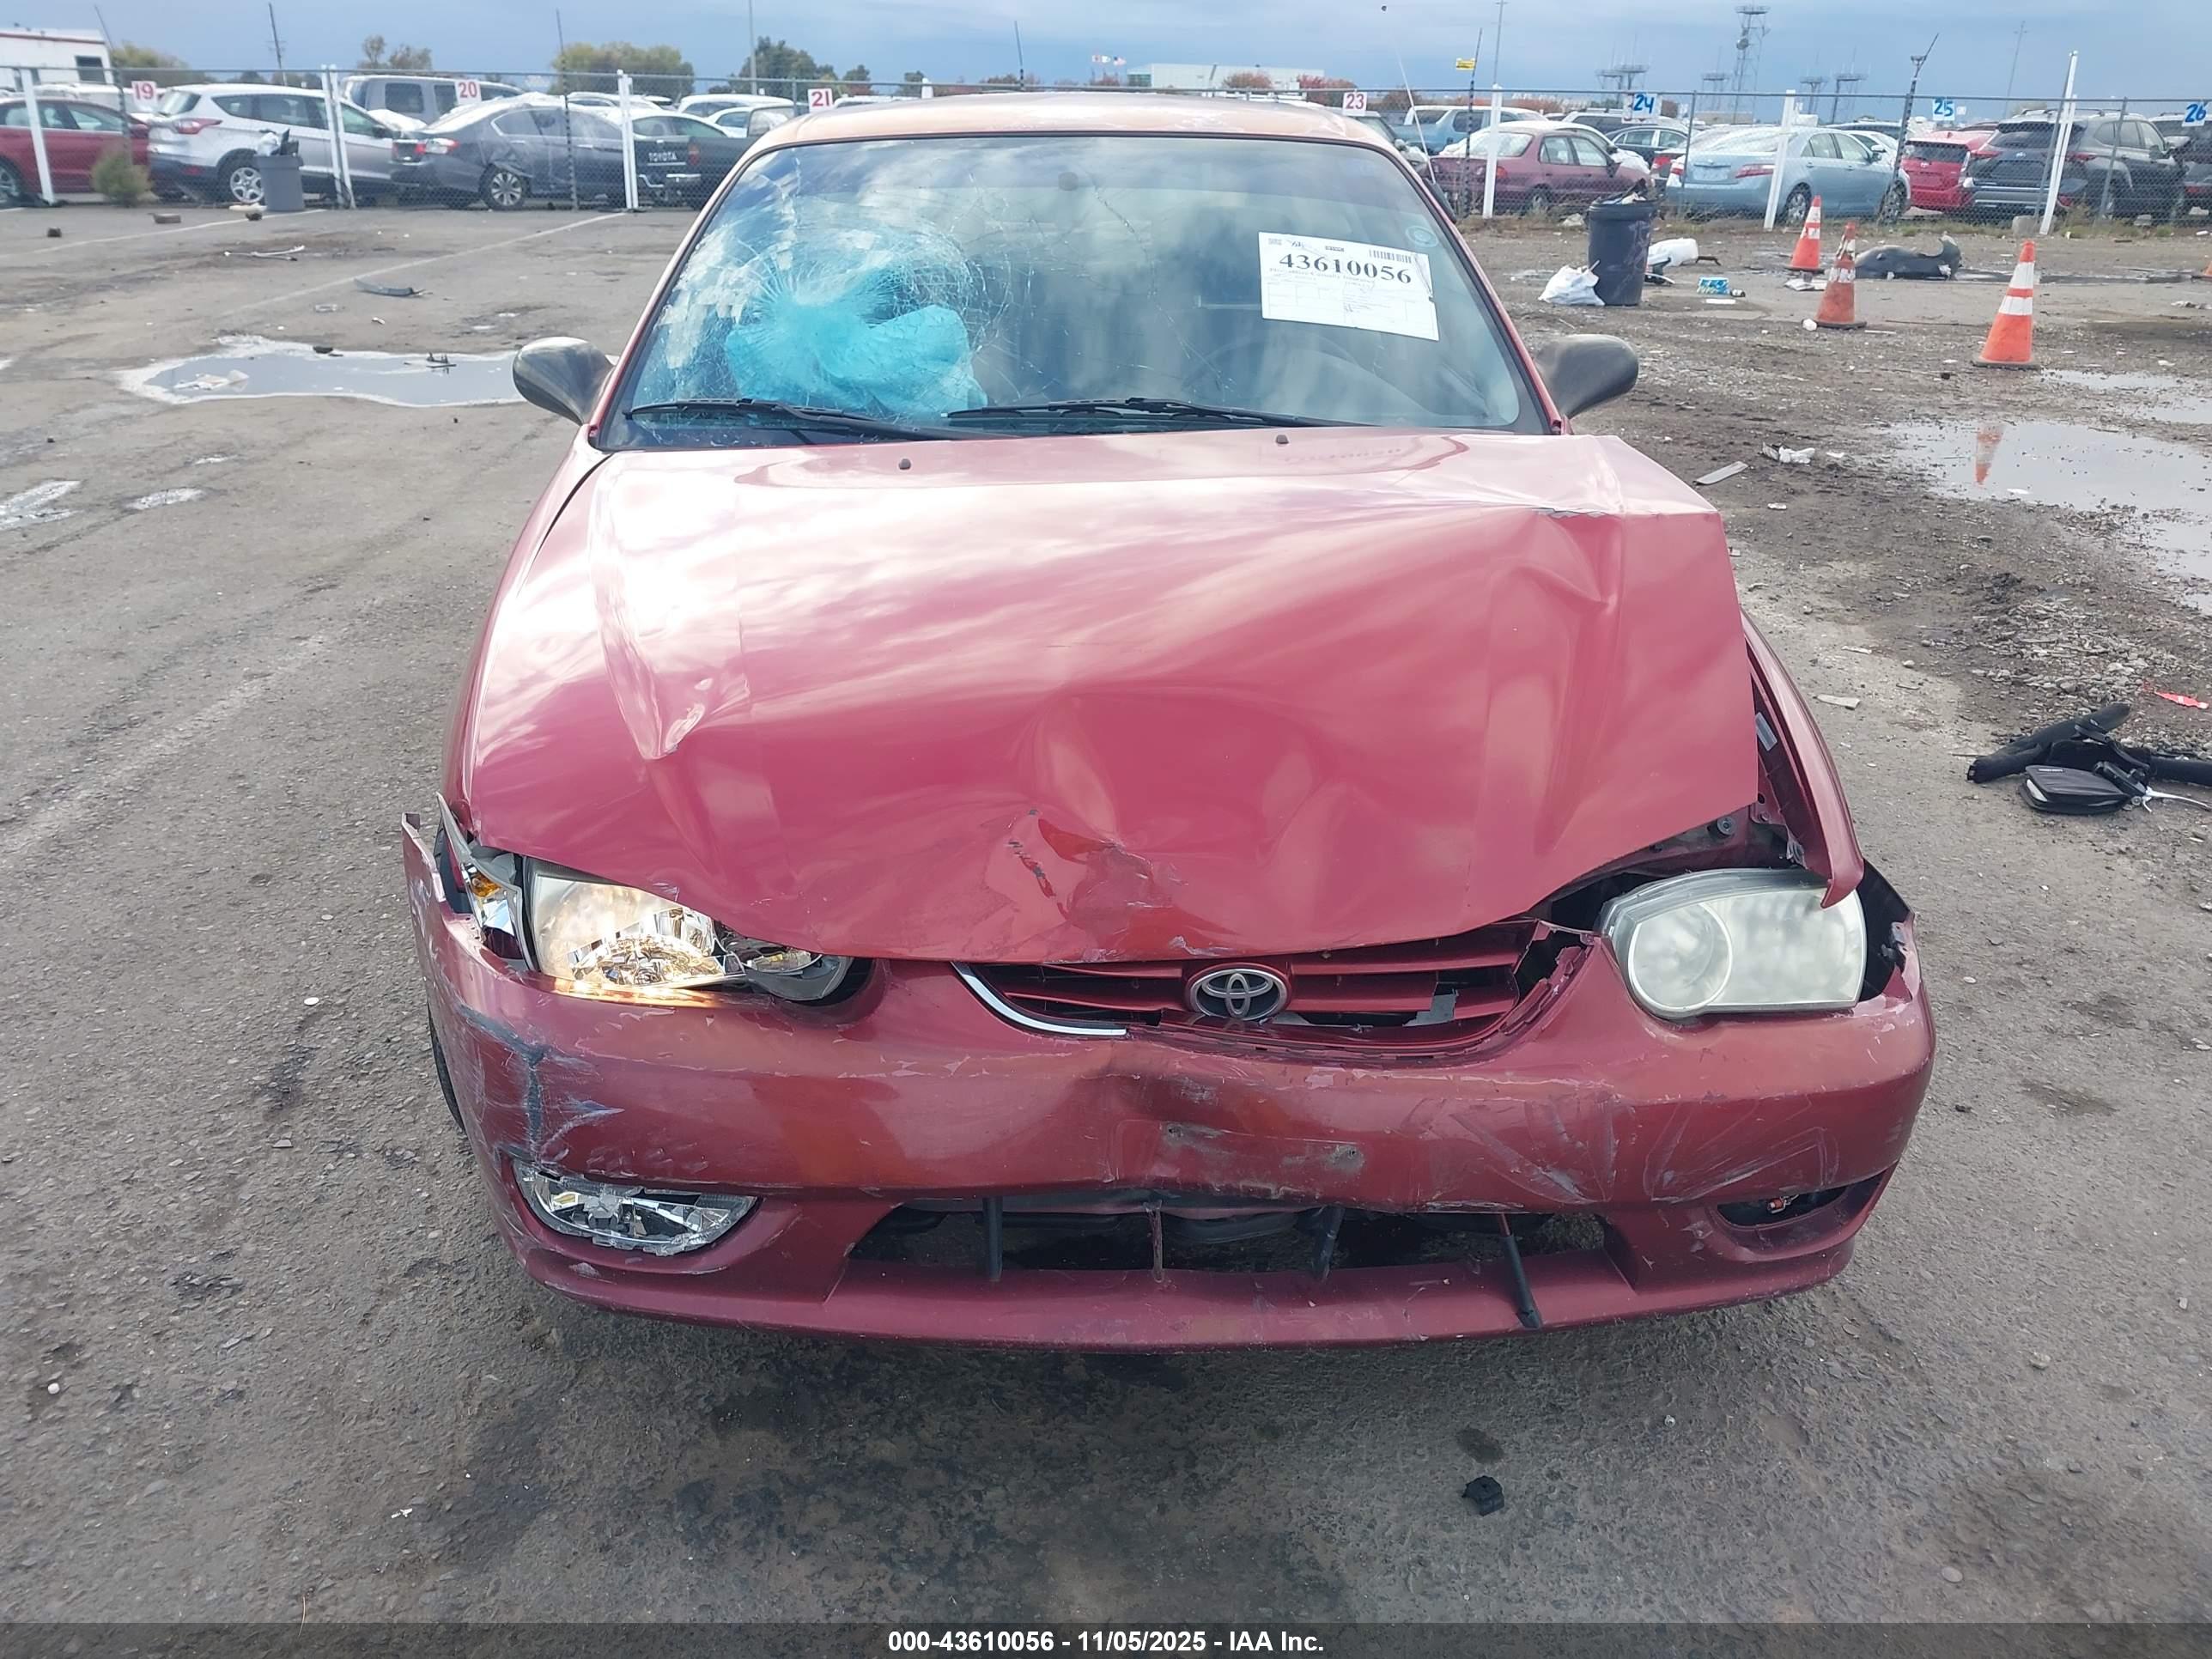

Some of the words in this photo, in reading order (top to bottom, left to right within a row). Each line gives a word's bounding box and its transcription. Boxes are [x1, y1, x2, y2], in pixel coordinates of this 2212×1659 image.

[134, 82, 154, 100] 19
[459, 82, 477, 99] 20
[811, 90, 829, 107] 21
[1345, 93, 1364, 110] 23
[1633, 93, 1655, 114] 24
[1934, 98, 1954, 118] 25
[2185, 102, 2208, 123] 26
[647, 151, 678, 162] TOYOTA
[1279, 253, 1412, 284] 43610056
